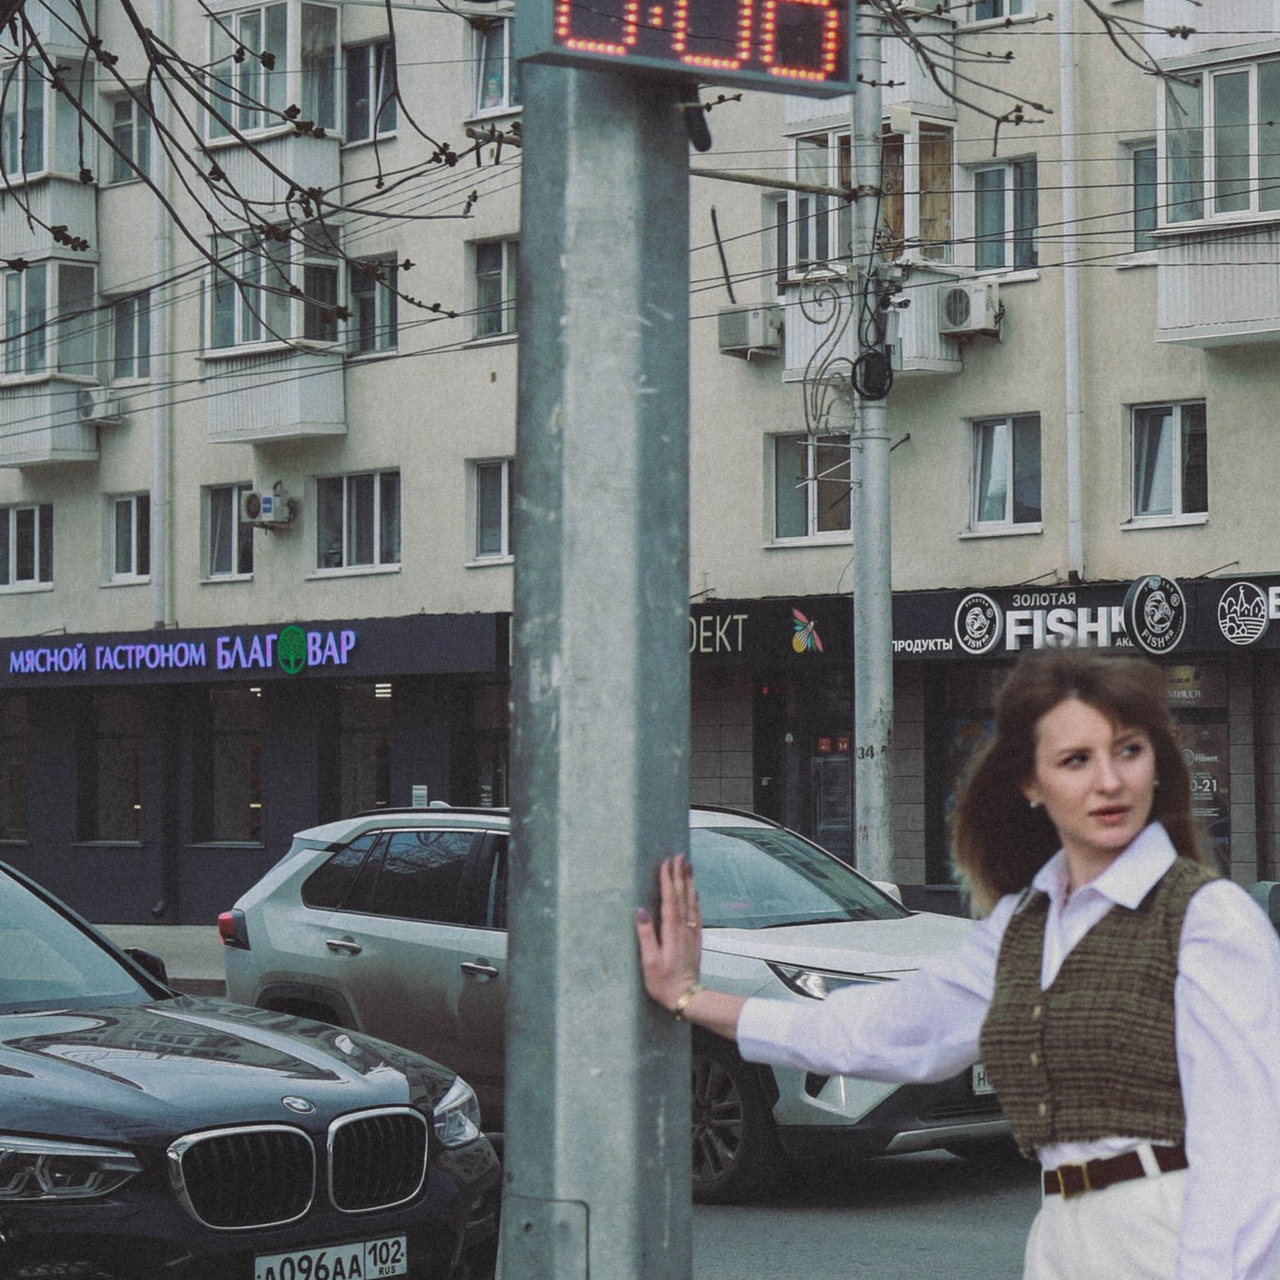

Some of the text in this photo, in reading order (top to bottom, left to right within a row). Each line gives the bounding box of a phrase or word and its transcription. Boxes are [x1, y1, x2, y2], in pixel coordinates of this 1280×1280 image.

[1012, 591, 1077, 608] ЗОЛОТАЯ
[9, 642, 87, 674] МЯСНОЙ
[95, 641, 207, 671] ГАСТРОНОМ
[367, 1239, 402, 1268] 102
[378, 1265, 397, 1277] RUS
